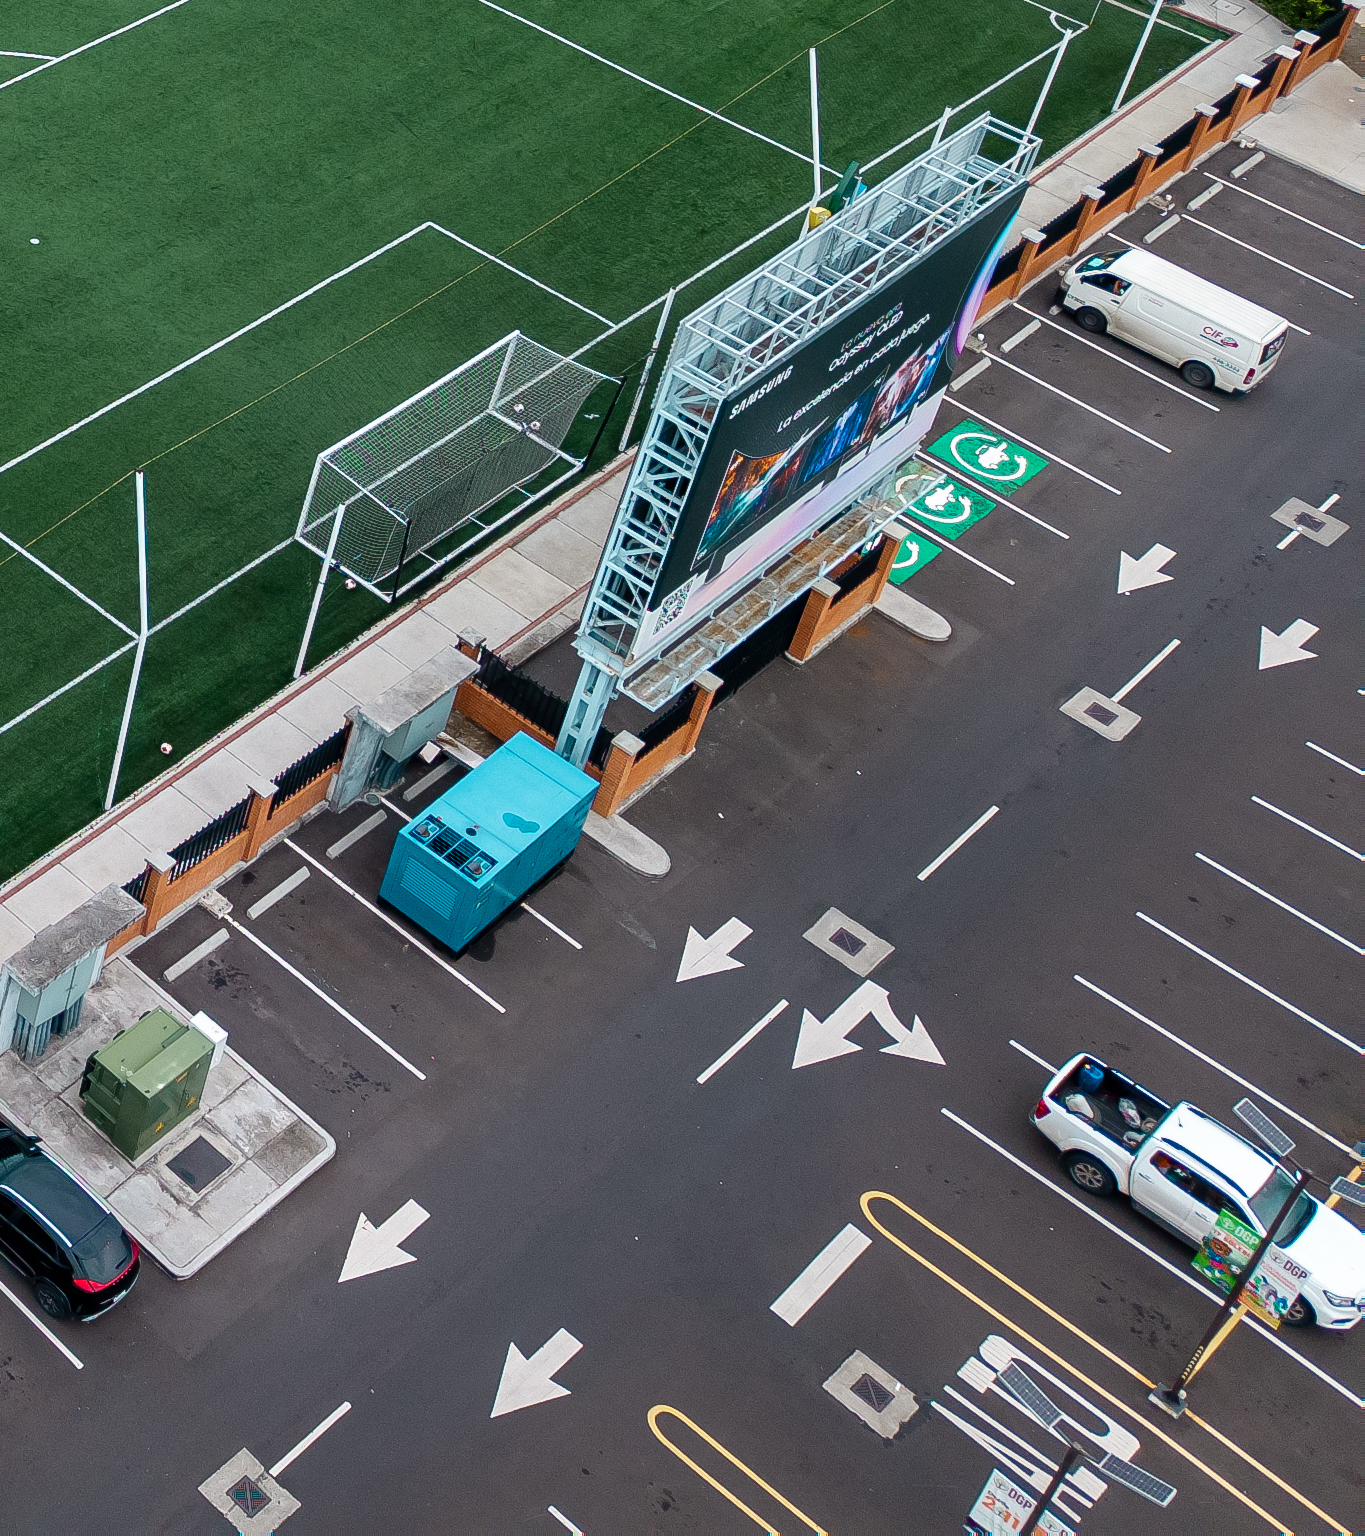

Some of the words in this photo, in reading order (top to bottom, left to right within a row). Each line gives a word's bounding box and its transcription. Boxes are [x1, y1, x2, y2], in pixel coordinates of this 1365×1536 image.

[828, 331, 876, 372] Odyssey
[877, 310, 904, 337] OLED
[1203, 326, 1224, 339] CIF
[729, 365, 793, 419] SAMSUNG
[777, 415, 792, 433] La
[793, 370, 854, 421] excelencia
[854, 359, 869, 375] en
[869, 336, 899, 363] cada
[1234, 1227, 1259, 1245] DGP
[1282, 1259, 1308, 1280] DGP
[930, 1333, 1141, 1523] ALTO
[1008, 1487, 1032, 1509] DGP
